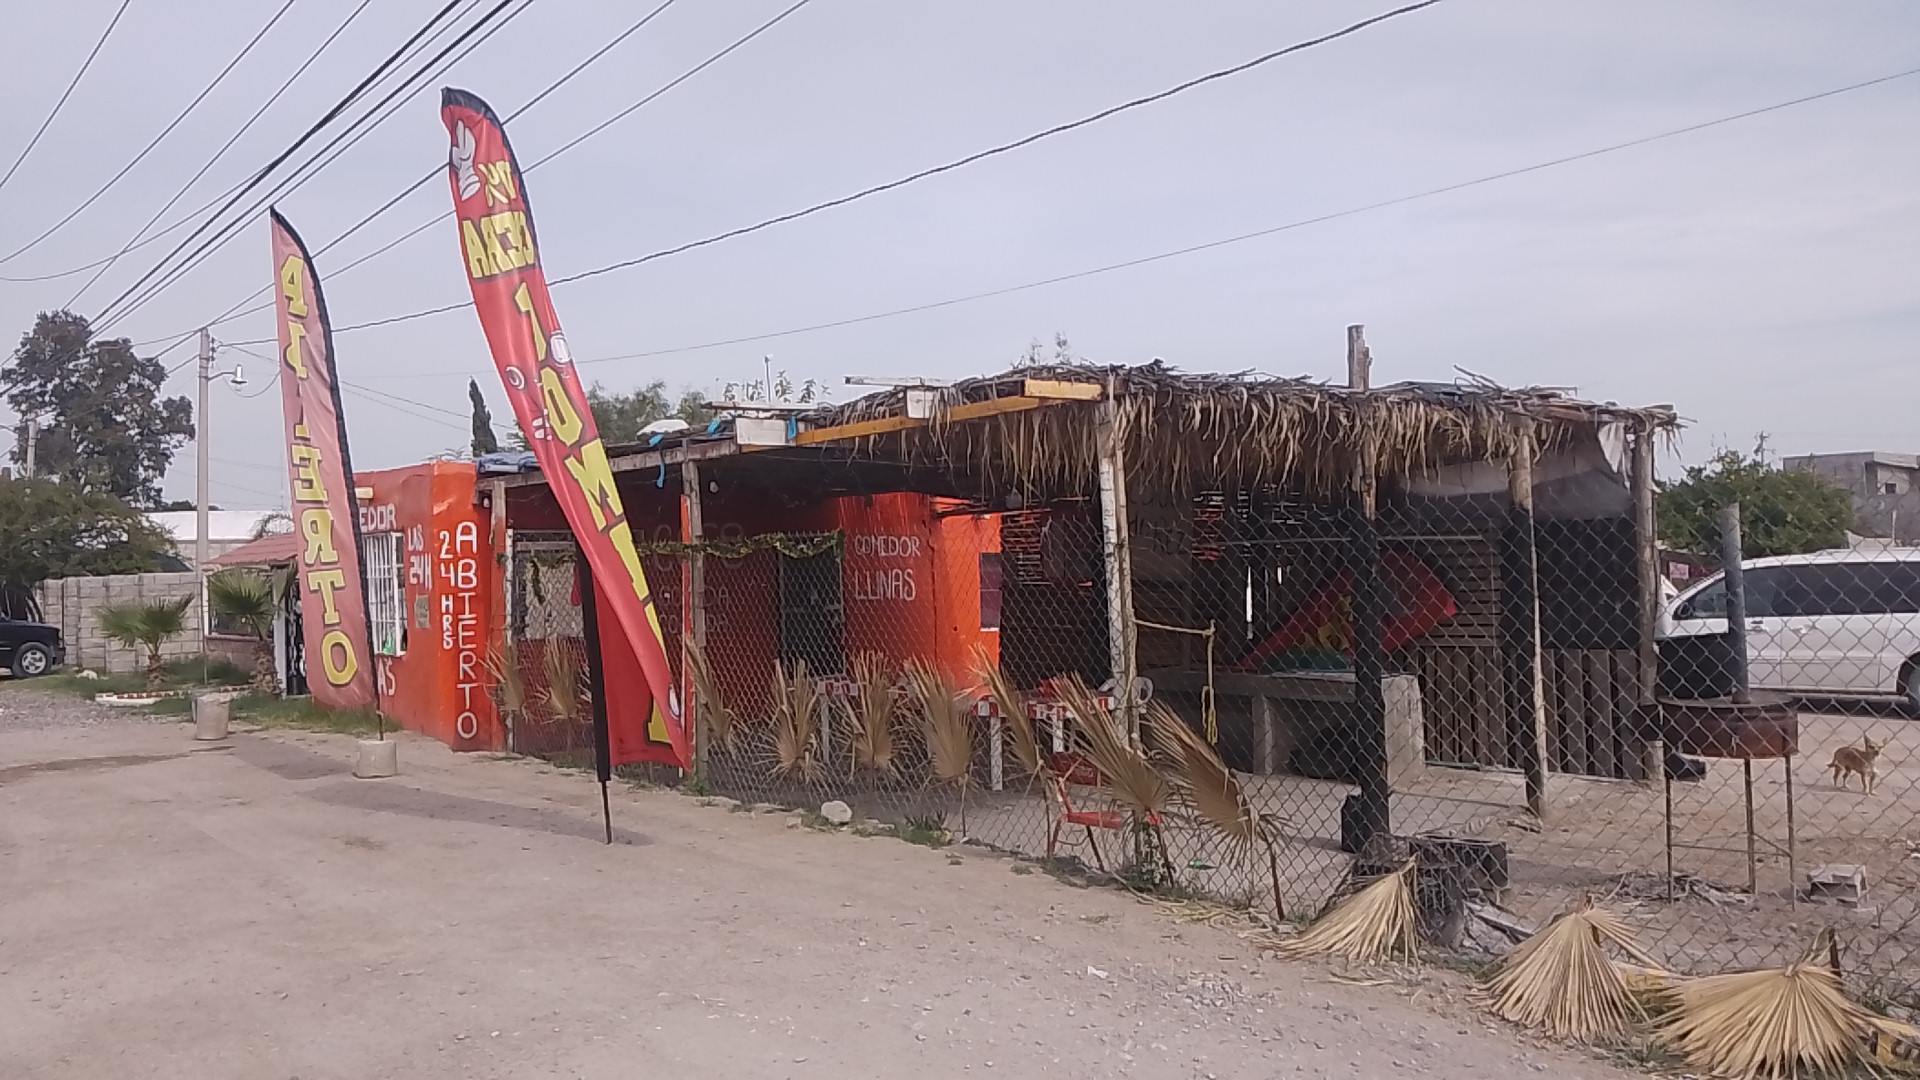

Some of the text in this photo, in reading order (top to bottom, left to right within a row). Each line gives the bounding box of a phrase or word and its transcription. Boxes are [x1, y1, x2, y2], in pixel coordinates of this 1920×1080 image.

[359, 503, 397, 534] EDOR
[854, 534, 921, 557] COMEDOR
[438, 530, 456, 650] 24 HRS
[455, 521, 478, 739] ABIERTO
